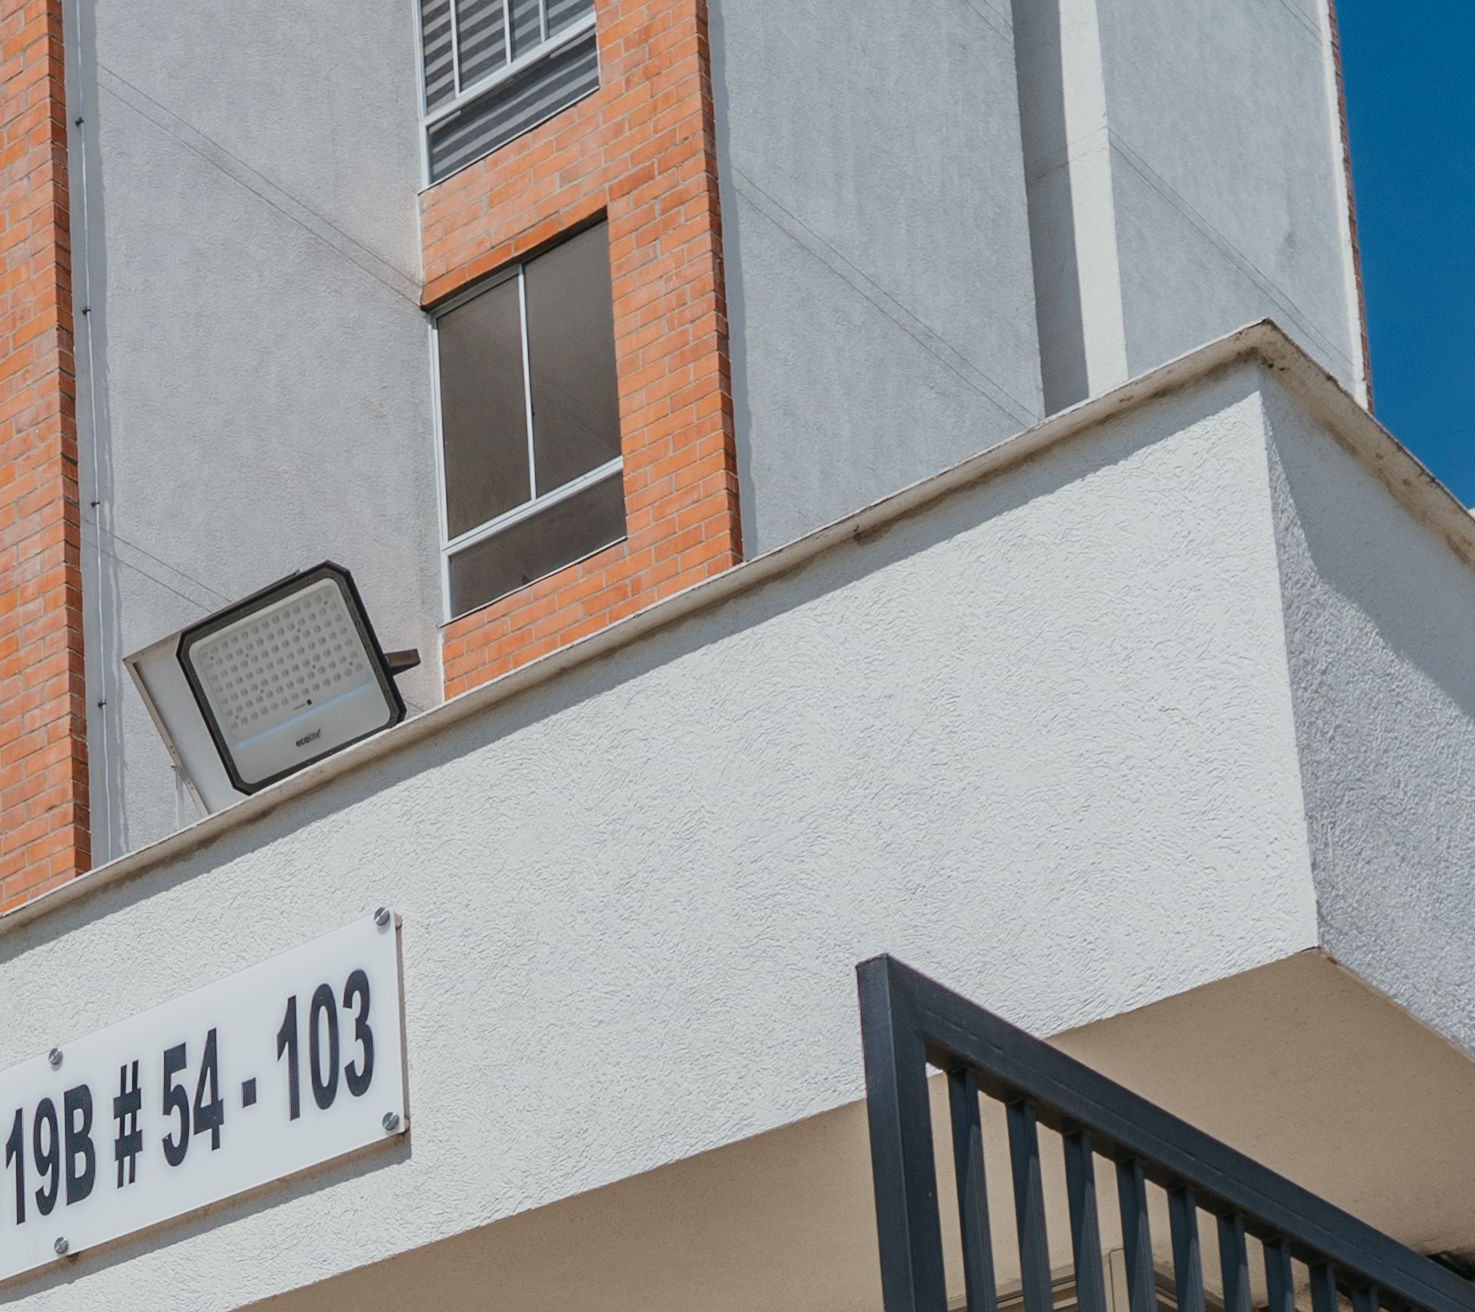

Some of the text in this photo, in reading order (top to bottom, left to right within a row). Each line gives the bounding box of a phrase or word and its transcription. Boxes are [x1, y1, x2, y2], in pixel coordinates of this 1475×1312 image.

[113, 1059, 143, 1189] #
[161, 1027, 224, 1168] 54
[240, 1076, 258, 1108] -
[276, 969, 375, 1121] 103
